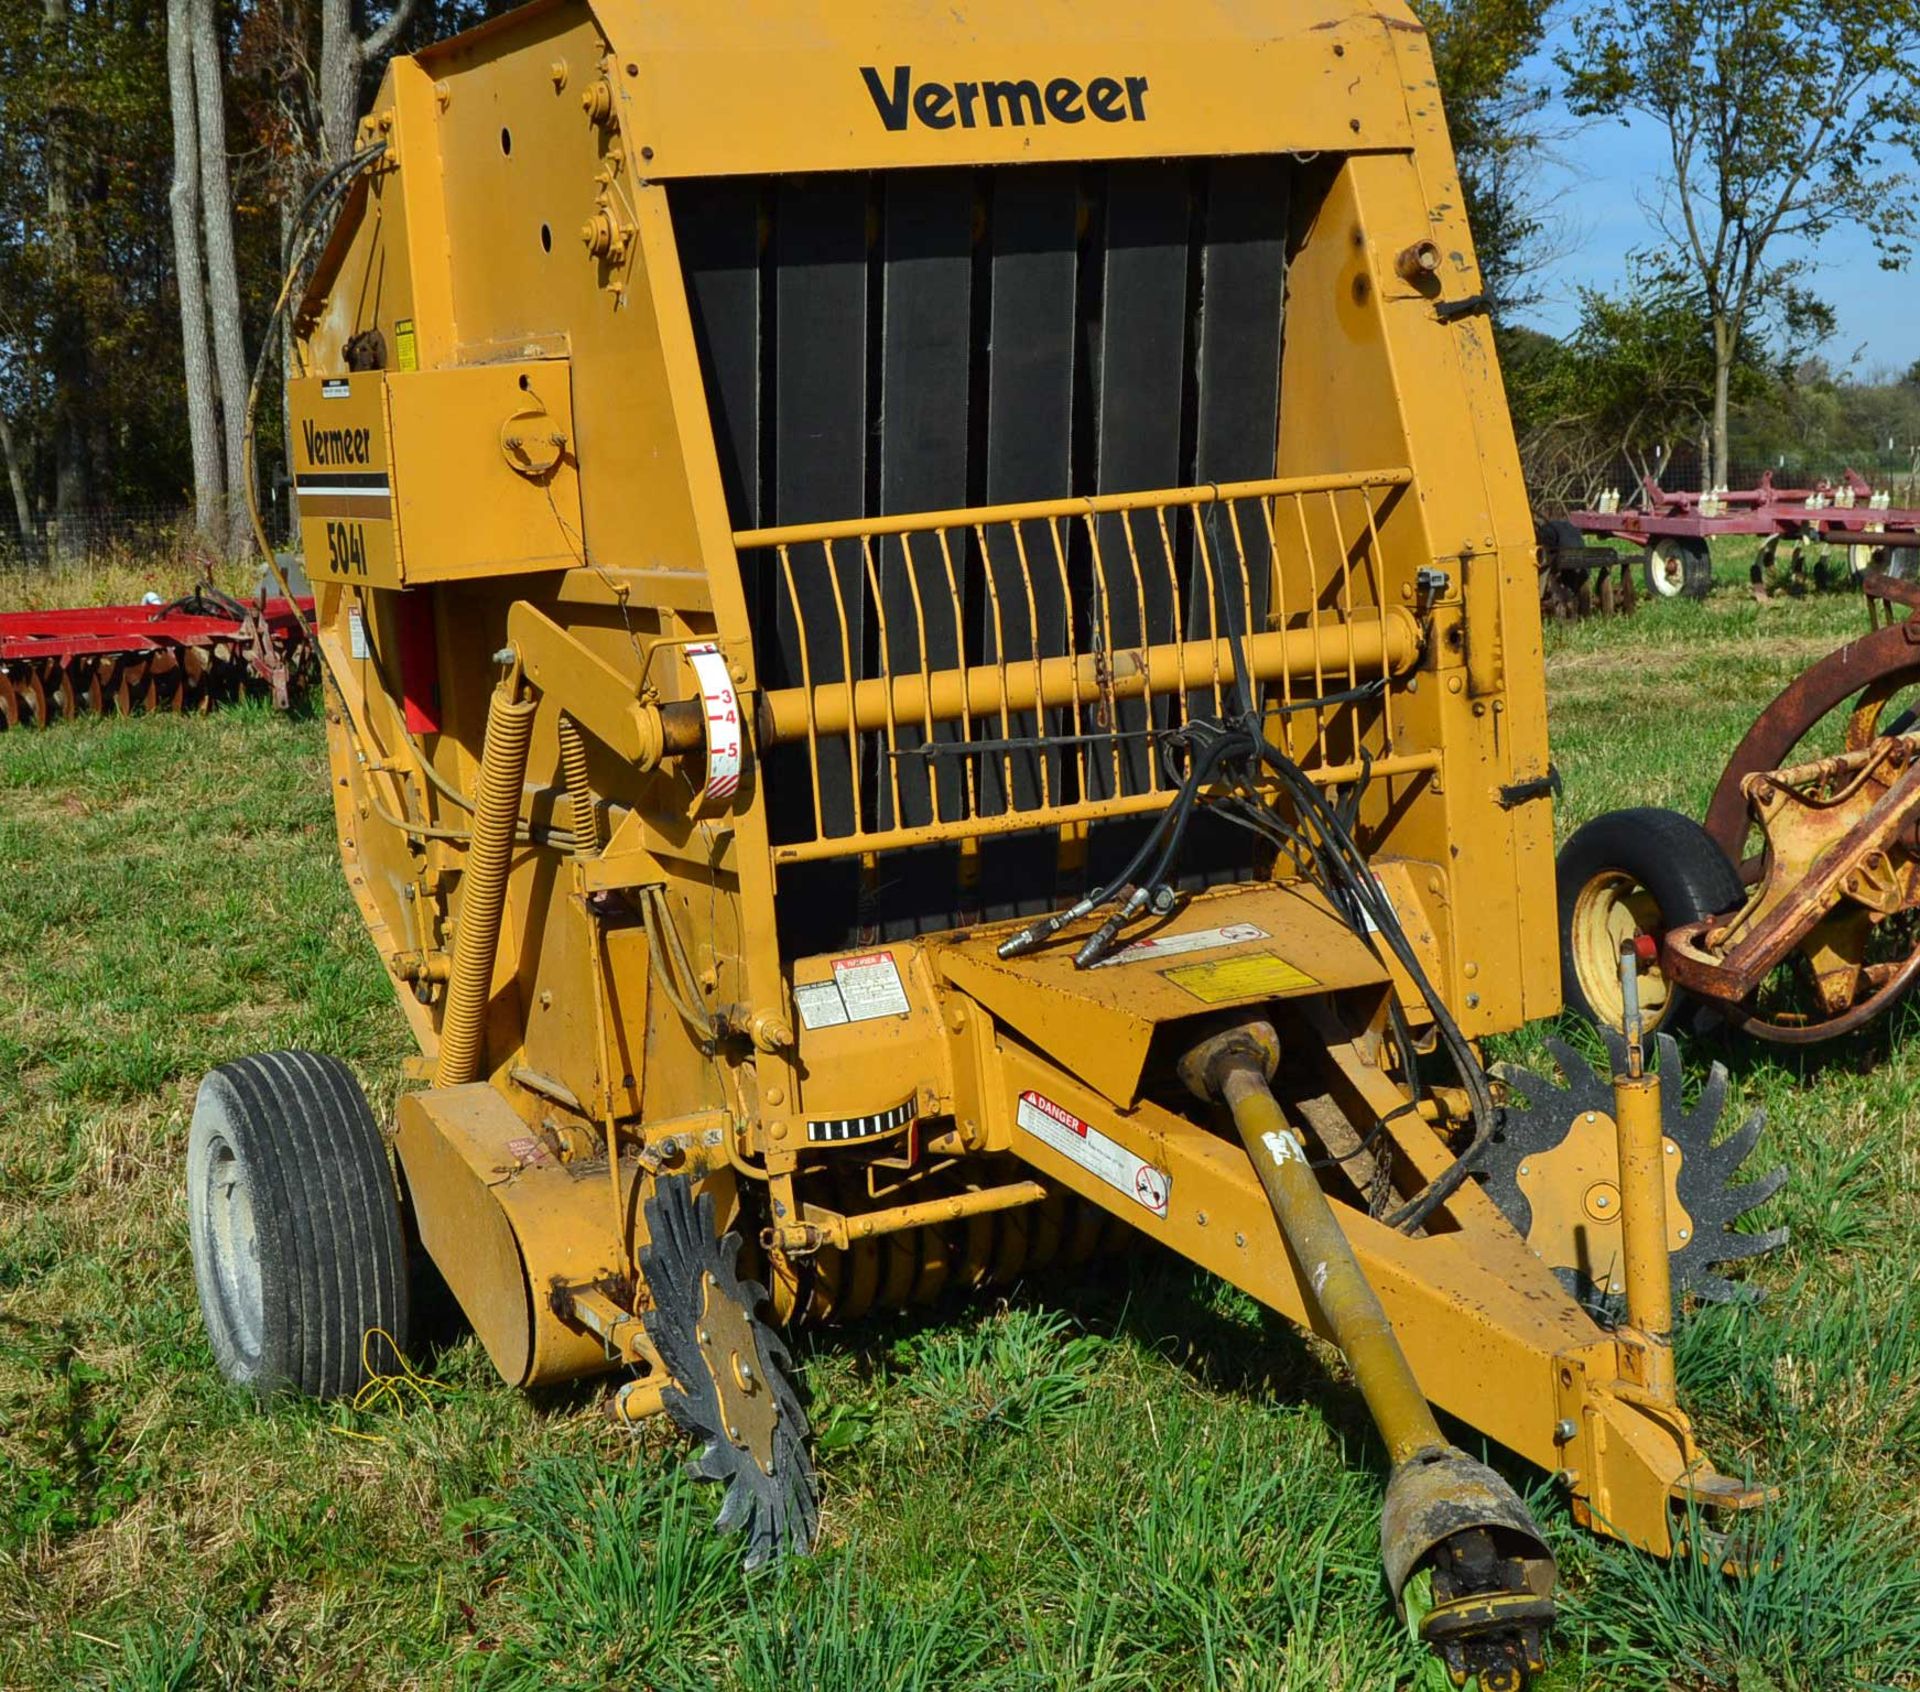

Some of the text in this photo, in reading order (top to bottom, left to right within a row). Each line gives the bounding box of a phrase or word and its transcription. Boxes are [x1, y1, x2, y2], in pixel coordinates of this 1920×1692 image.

[859, 65, 1149, 131] Vermeer
[302, 420, 370, 465] Vermeer
[326, 522, 368, 575] 5041
[721, 689, 733, 704] 3
[725, 710, 737, 724] 4
[727, 742, 739, 757] 5
[1037, 1096, 1080, 1132] DANGER
